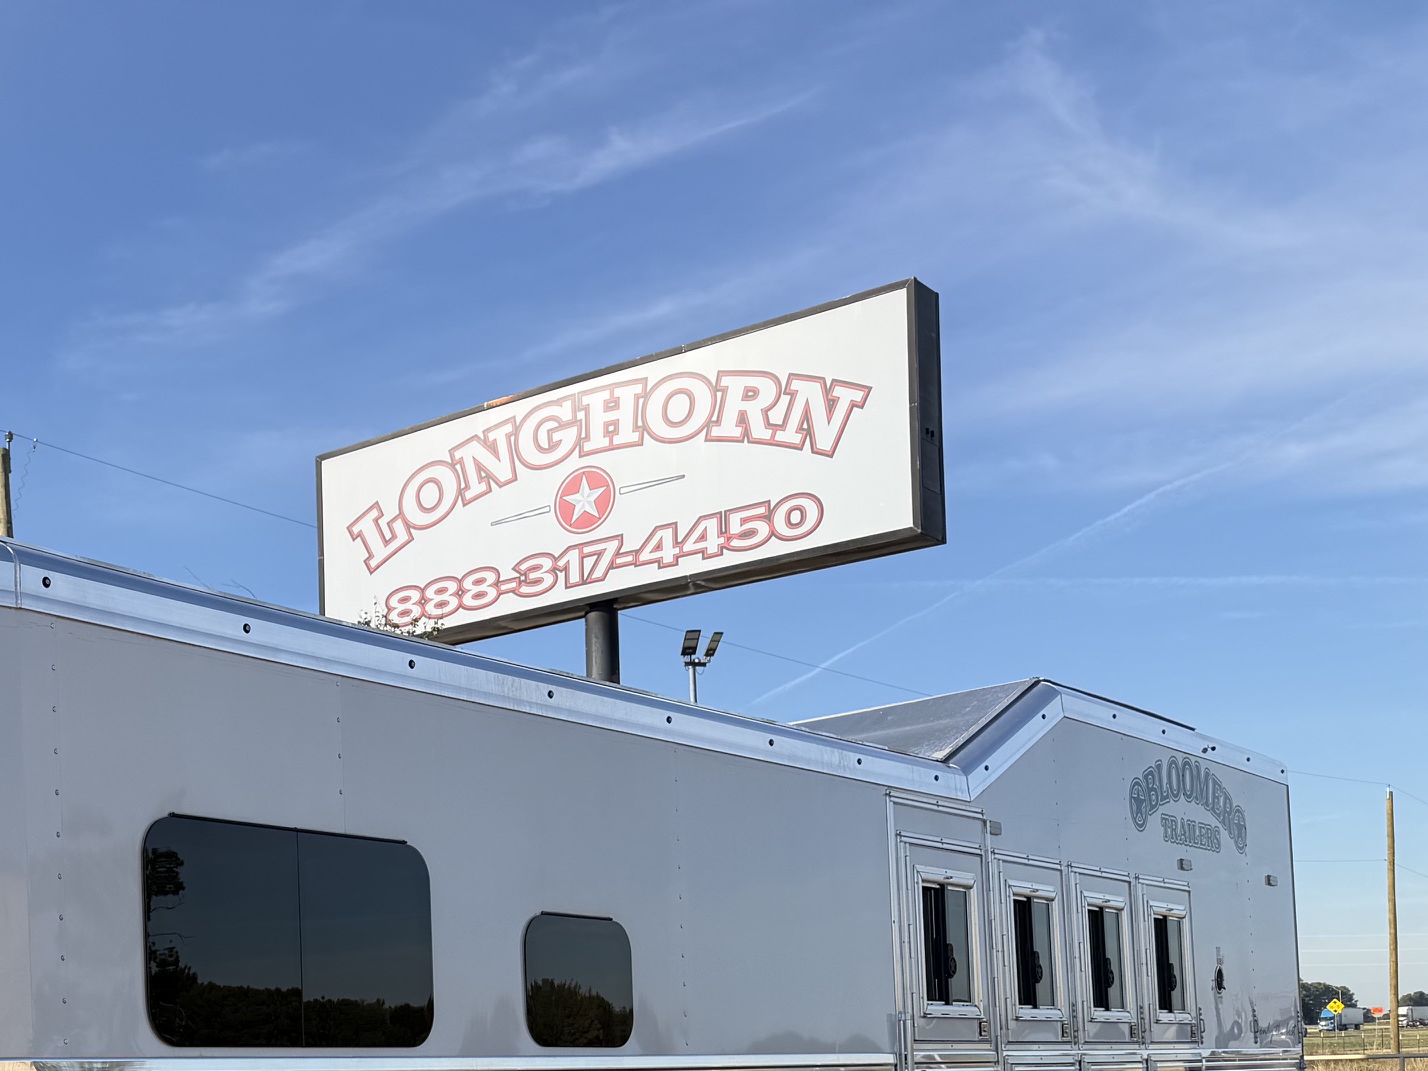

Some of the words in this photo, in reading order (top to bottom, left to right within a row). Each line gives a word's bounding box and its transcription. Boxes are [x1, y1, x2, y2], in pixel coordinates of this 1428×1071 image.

[348, 370, 872, 575] LONGHORN
[385, 492, 824, 628] 888-317-4450
[1142, 756, 1234, 839] BLOOMER
[1161, 813, 1221, 853] TRAILERS
